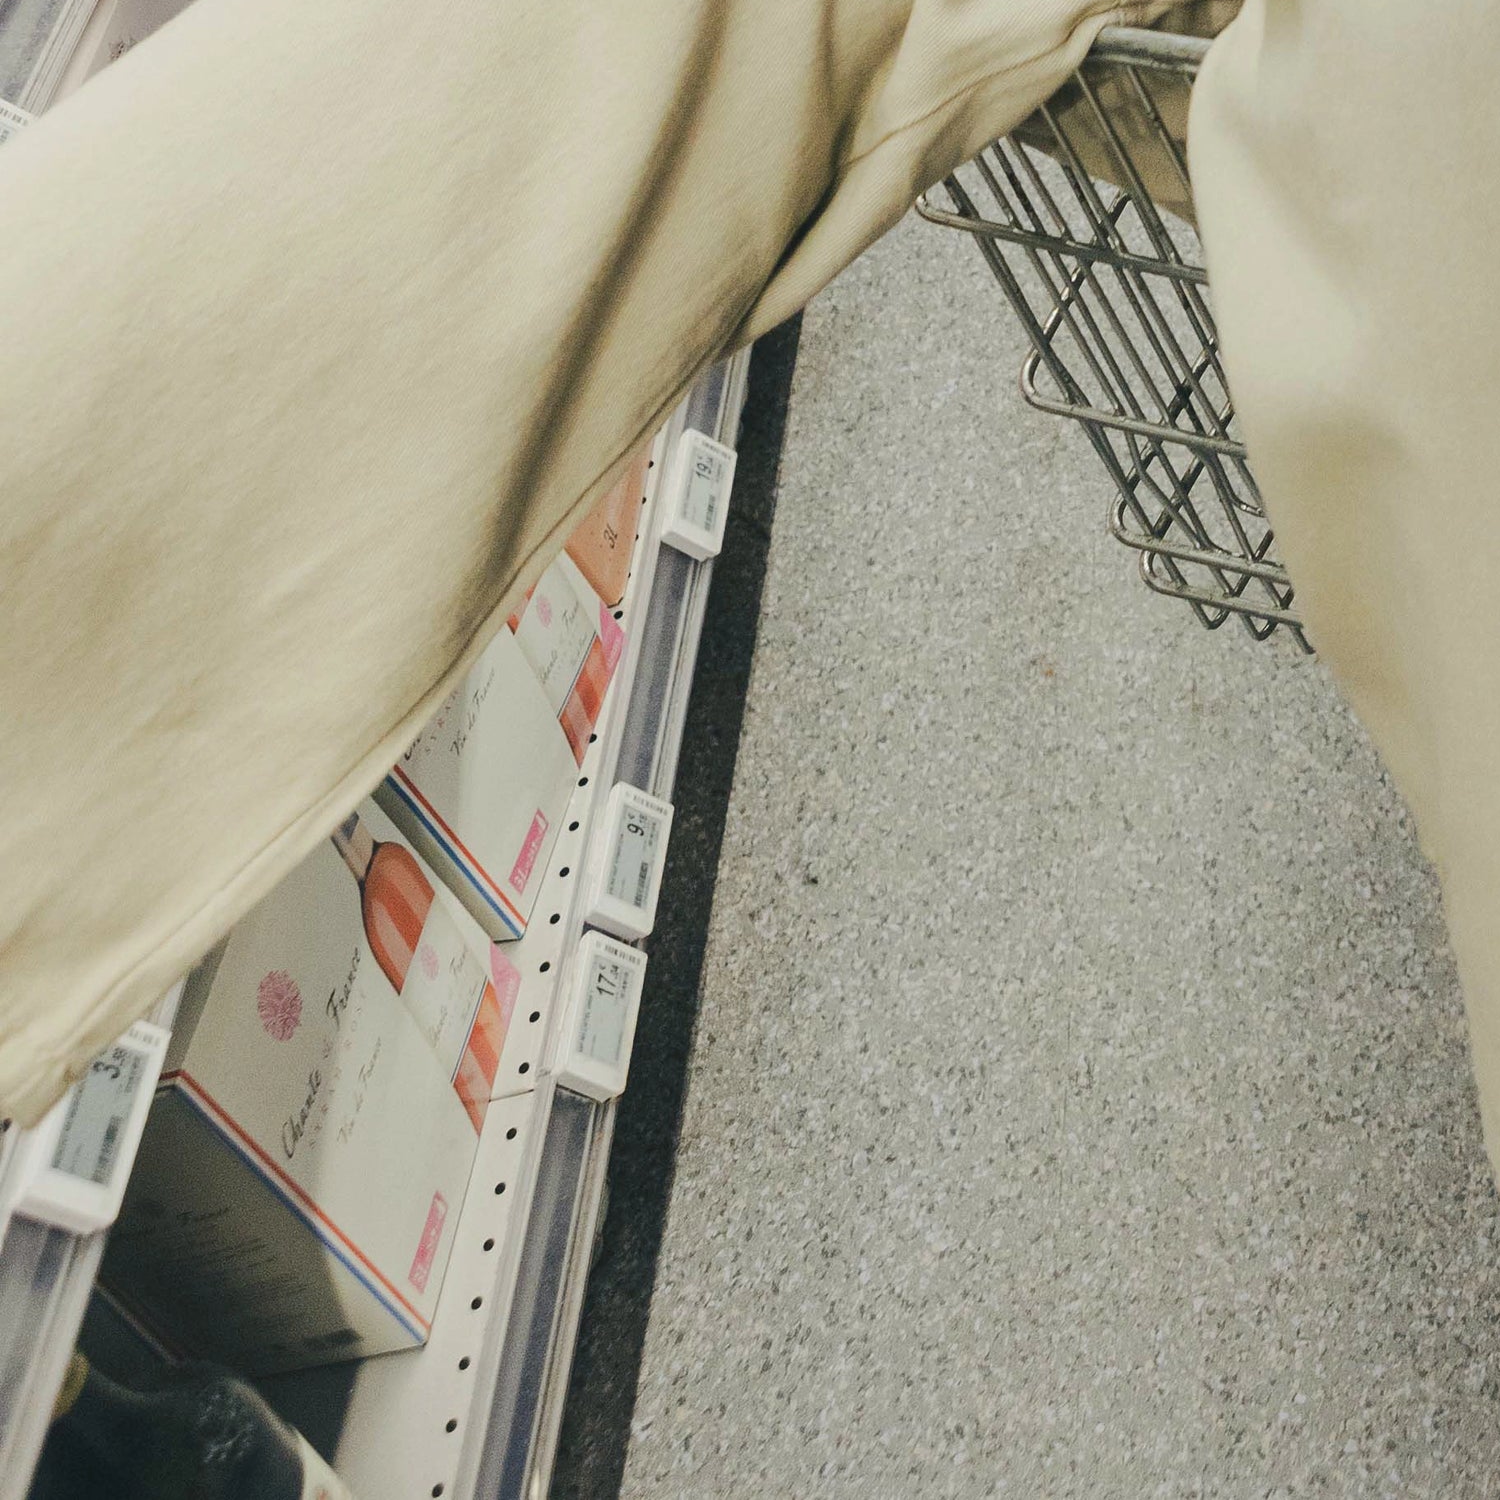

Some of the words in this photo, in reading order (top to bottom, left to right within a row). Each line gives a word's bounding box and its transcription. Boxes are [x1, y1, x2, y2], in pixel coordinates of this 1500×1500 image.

[449, 735, 468, 758] Vin
[472, 665, 497, 712] France
[626, 821, 645, 838] 9
[326, 946, 362, 1034] France
[595, 972, 617, 998] 17
[281, 1067, 322, 1161] Chante
